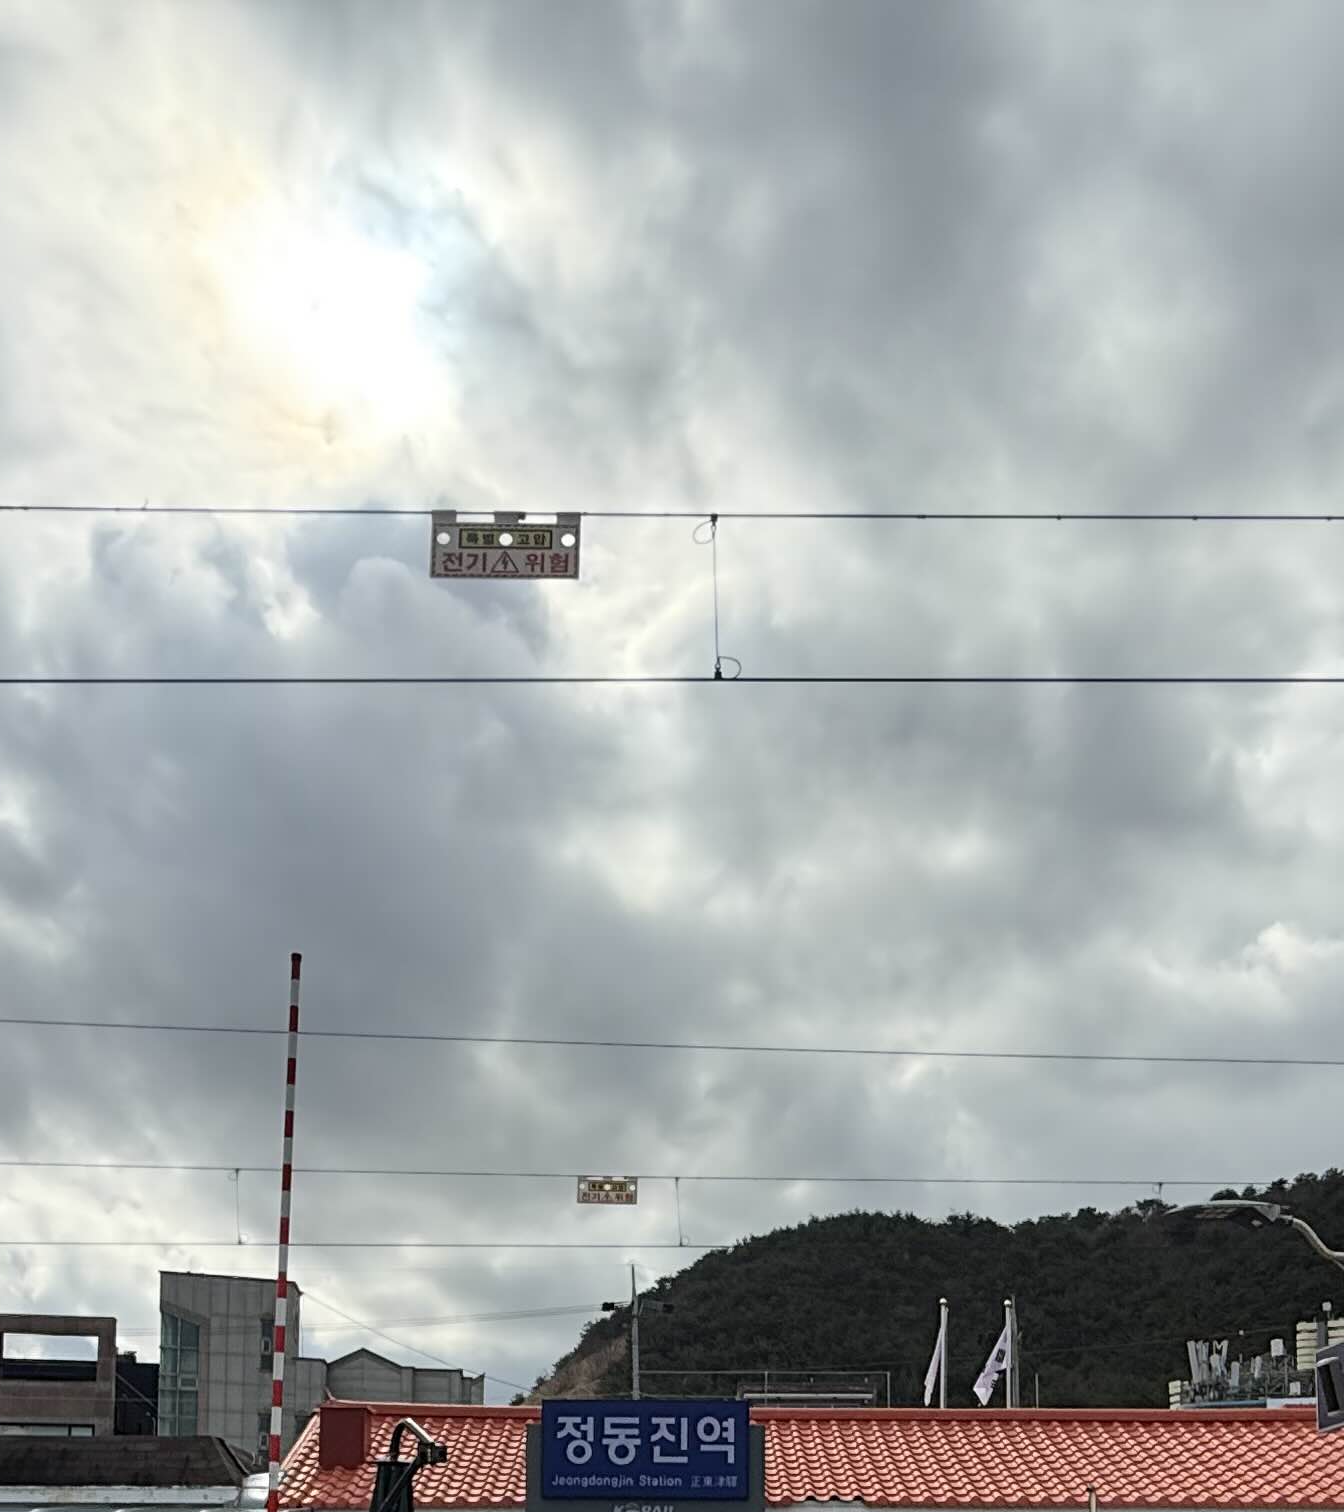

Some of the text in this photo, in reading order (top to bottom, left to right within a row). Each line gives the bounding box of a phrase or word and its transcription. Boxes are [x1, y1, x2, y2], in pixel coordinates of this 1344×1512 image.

[442, 552, 569, 573] 전기 위험
[556, 1416, 736, 1465] 정동진역
[552, 1474, 634, 1489] Jeongdongjin
[639, 1474, 682, 1487] Station
